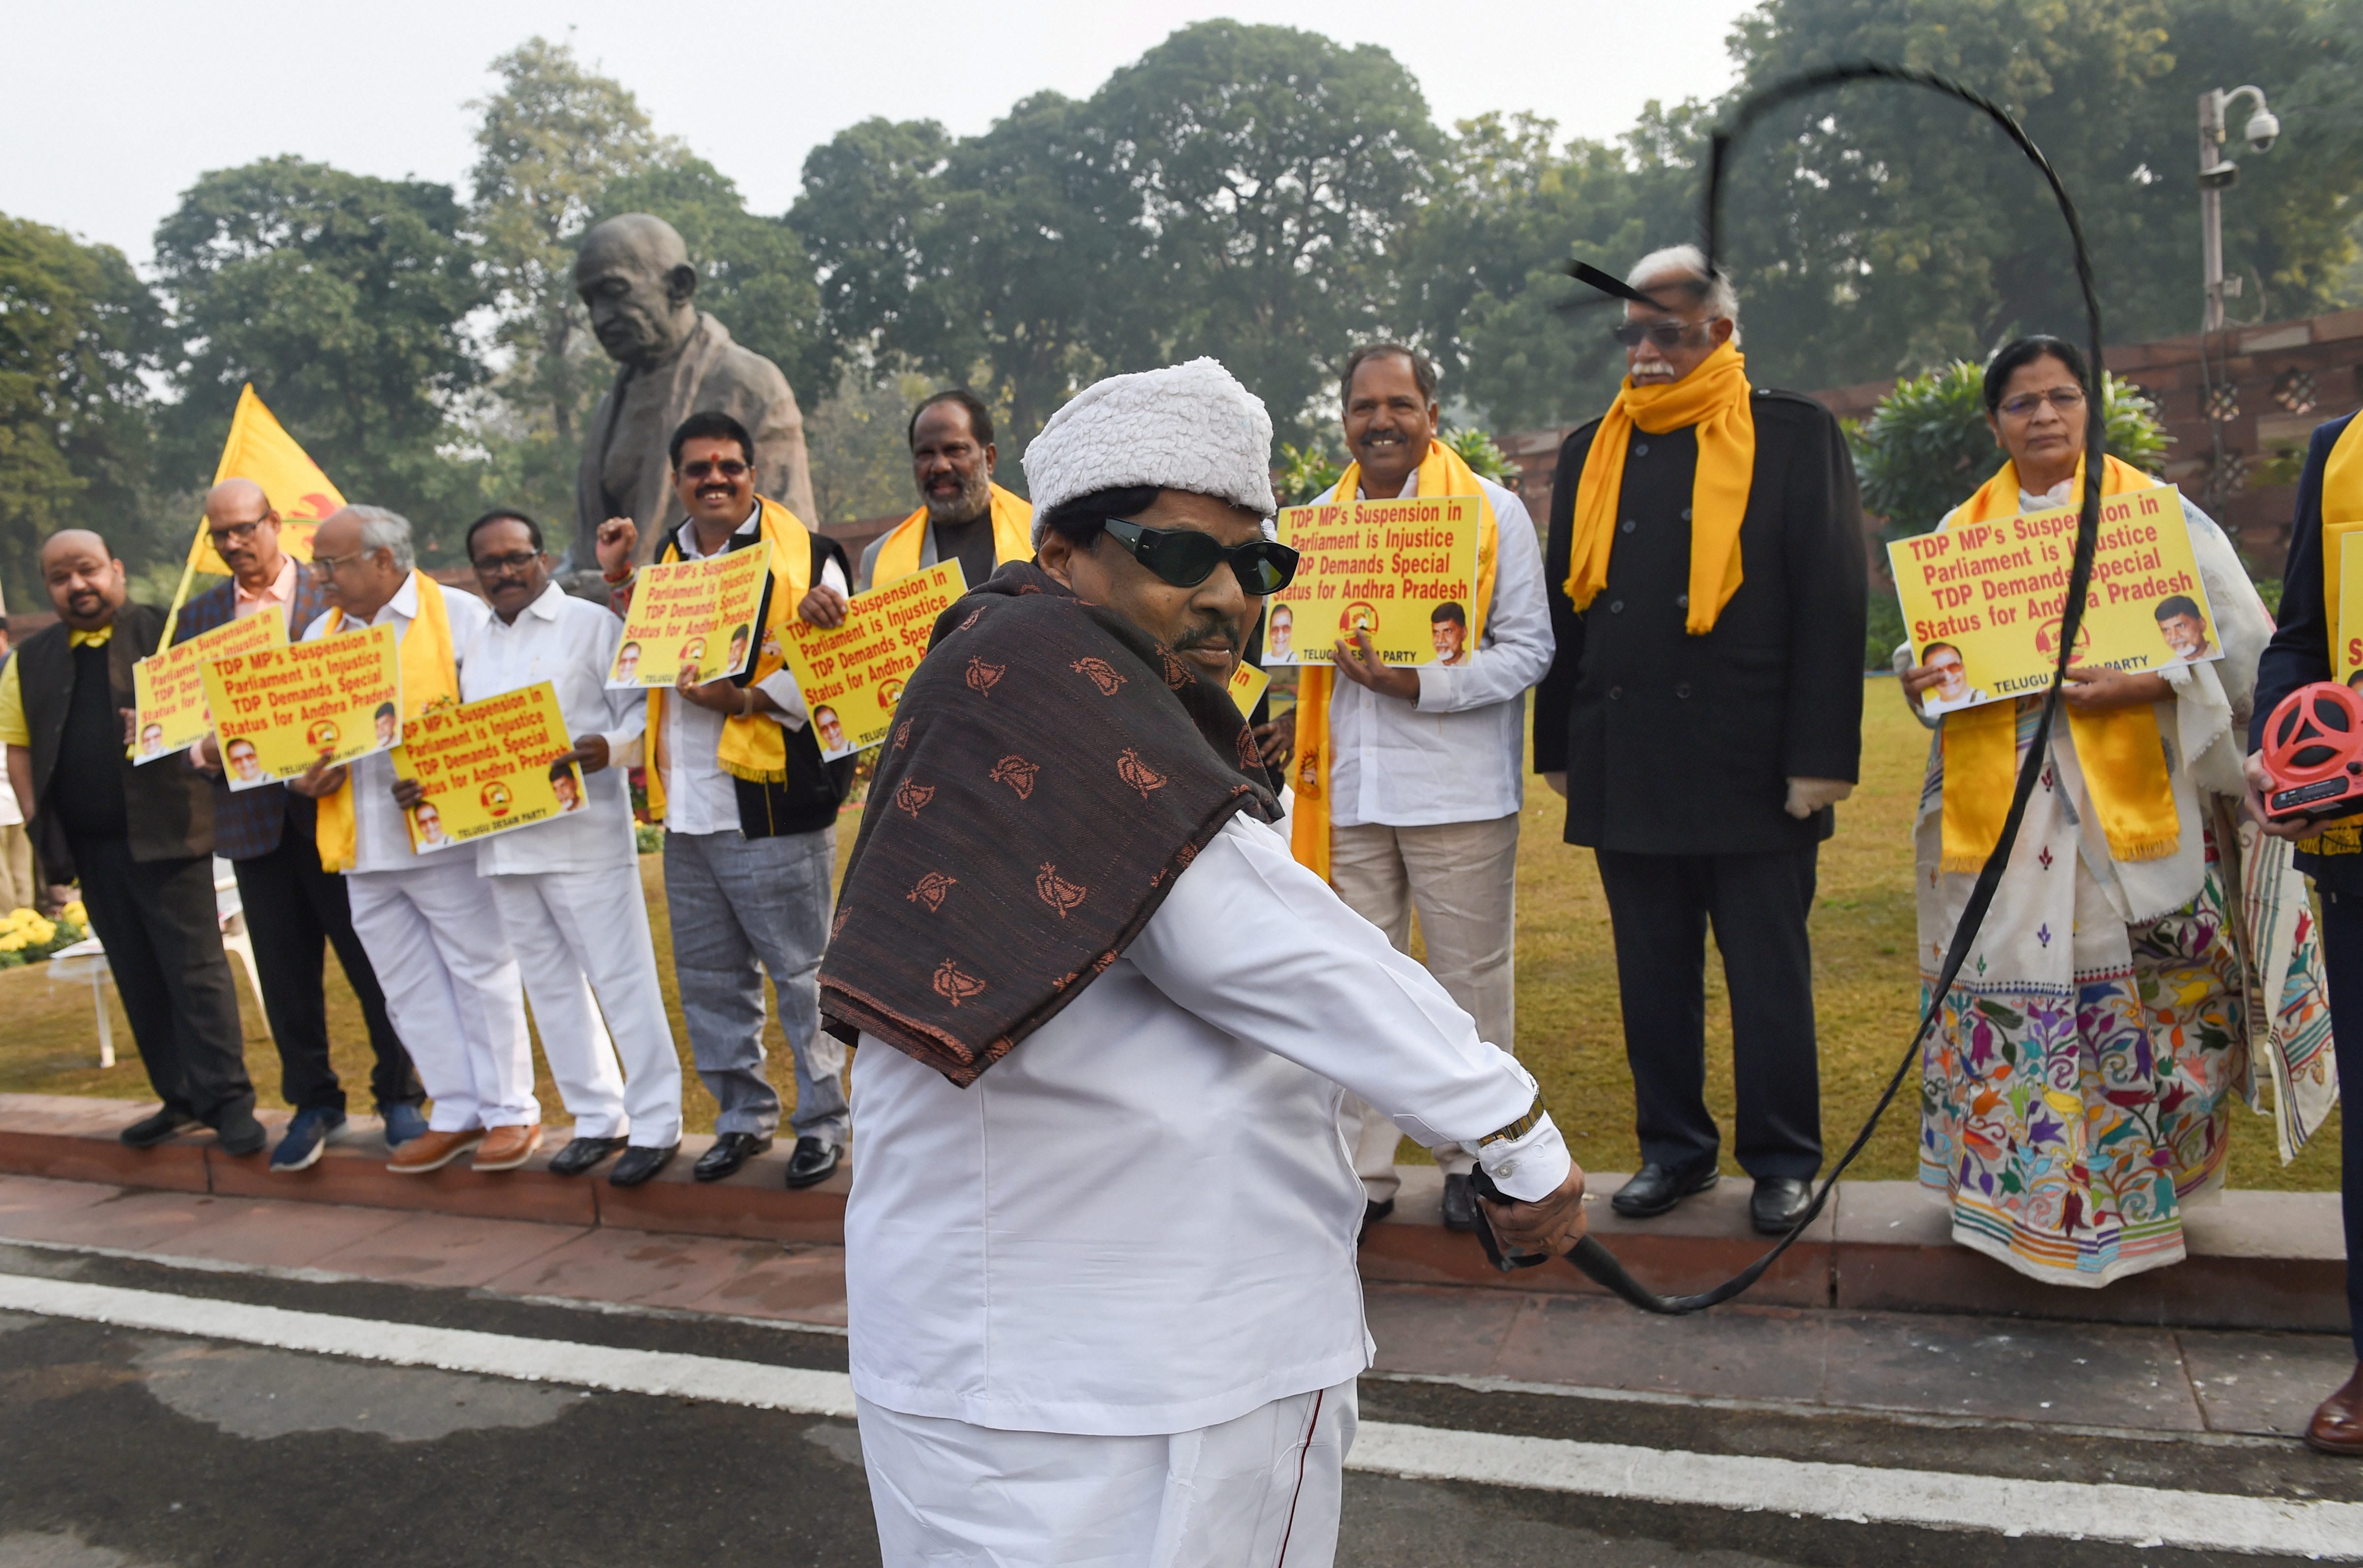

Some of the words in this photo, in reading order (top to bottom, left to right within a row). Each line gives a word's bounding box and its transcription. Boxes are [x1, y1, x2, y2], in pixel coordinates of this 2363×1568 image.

[1290, 508, 1313, 529] TDP
[1318, 506, 1347, 526] MP's
[1354, 501, 1439, 527] Suspension
[1447, 501, 1462, 522] in
[1909, 536, 1949, 560] TDP
[1960, 526, 2005, 552] MP's
[2013, 501, 2131, 540] Suspeion
[2138, 494, 2159, 515] in
[1291, 531, 1359, 552] Parliament
[1367, 529, 1378, 548] is
[1386, 526, 1454, 551] Injustice
[1923, 545, 2032, 586] Parliament
[2040, 541, 2060, 562] is
[2067, 525, 2157, 558] Iustice
[649, 567, 669, 582] TDP
[702, 553, 751, 578] Suspension
[755, 548, 763, 562] in
[1297, 557, 1314, 576] DP
[1320, 553, 1384, 574] Demands
[1392, 553, 1450, 577] Special
[647, 584, 704, 601] Parliament
[708, 581, 716, 595] is
[720, 570, 756, 592] Injustice
[850, 578, 927, 617] Suspension
[932, 569, 947, 586] in
[1318, 579, 1336, 599] for
[1341, 579, 1394, 598] Andhra
[1402, 579, 1467, 599] Pradesh
[1932, 585, 1973, 610] TDP
[645, 604, 667, 620] TDP
[671, 601, 716, 618] Demands
[720, 588, 750, 611] Special
[1915, 613, 1981, 642] Status
[1989, 599, 2016, 626] for
[2028, 593, 2100, 620] Anda
[2107, 570, 2194, 604] Pradesh
[626, 625, 662, 639] Status
[666, 623, 680, 637] for
[685, 619, 719, 636] Andhra
[721, 607, 755, 628] Pradesh
[799, 621, 866, 661] Parliament
[869, 617, 883, 633] is
[887, 595, 948, 630] Injustice
[214, 656, 243, 678] TDP
[289, 633, 367, 661] Suspension
[372, 627, 383, 644] in
[810, 657, 835, 680] TDP
[838, 637, 896, 669] Demands
[1383, 651, 1416, 662] PARTY
[224, 669, 303, 695] Parliament
[310, 661, 321, 677] is
[326, 651, 381, 675] Injustice
[805, 684, 844, 705] Status
[846, 672, 863, 690] for
[868, 655, 914, 682] Andhra
[1234, 664, 1250, 686] in
[1994, 673, 2049, 693] TELUGU
[232, 695, 261, 715] TDP
[268, 682, 333, 707] Demands
[338, 668, 382, 693] Special
[220, 716, 268, 738] Status
[274, 709, 293, 727] for
[301, 697, 348, 721] Andhra
[352, 683, 397, 705] Pradesh
[403, 722, 418, 739] DP
